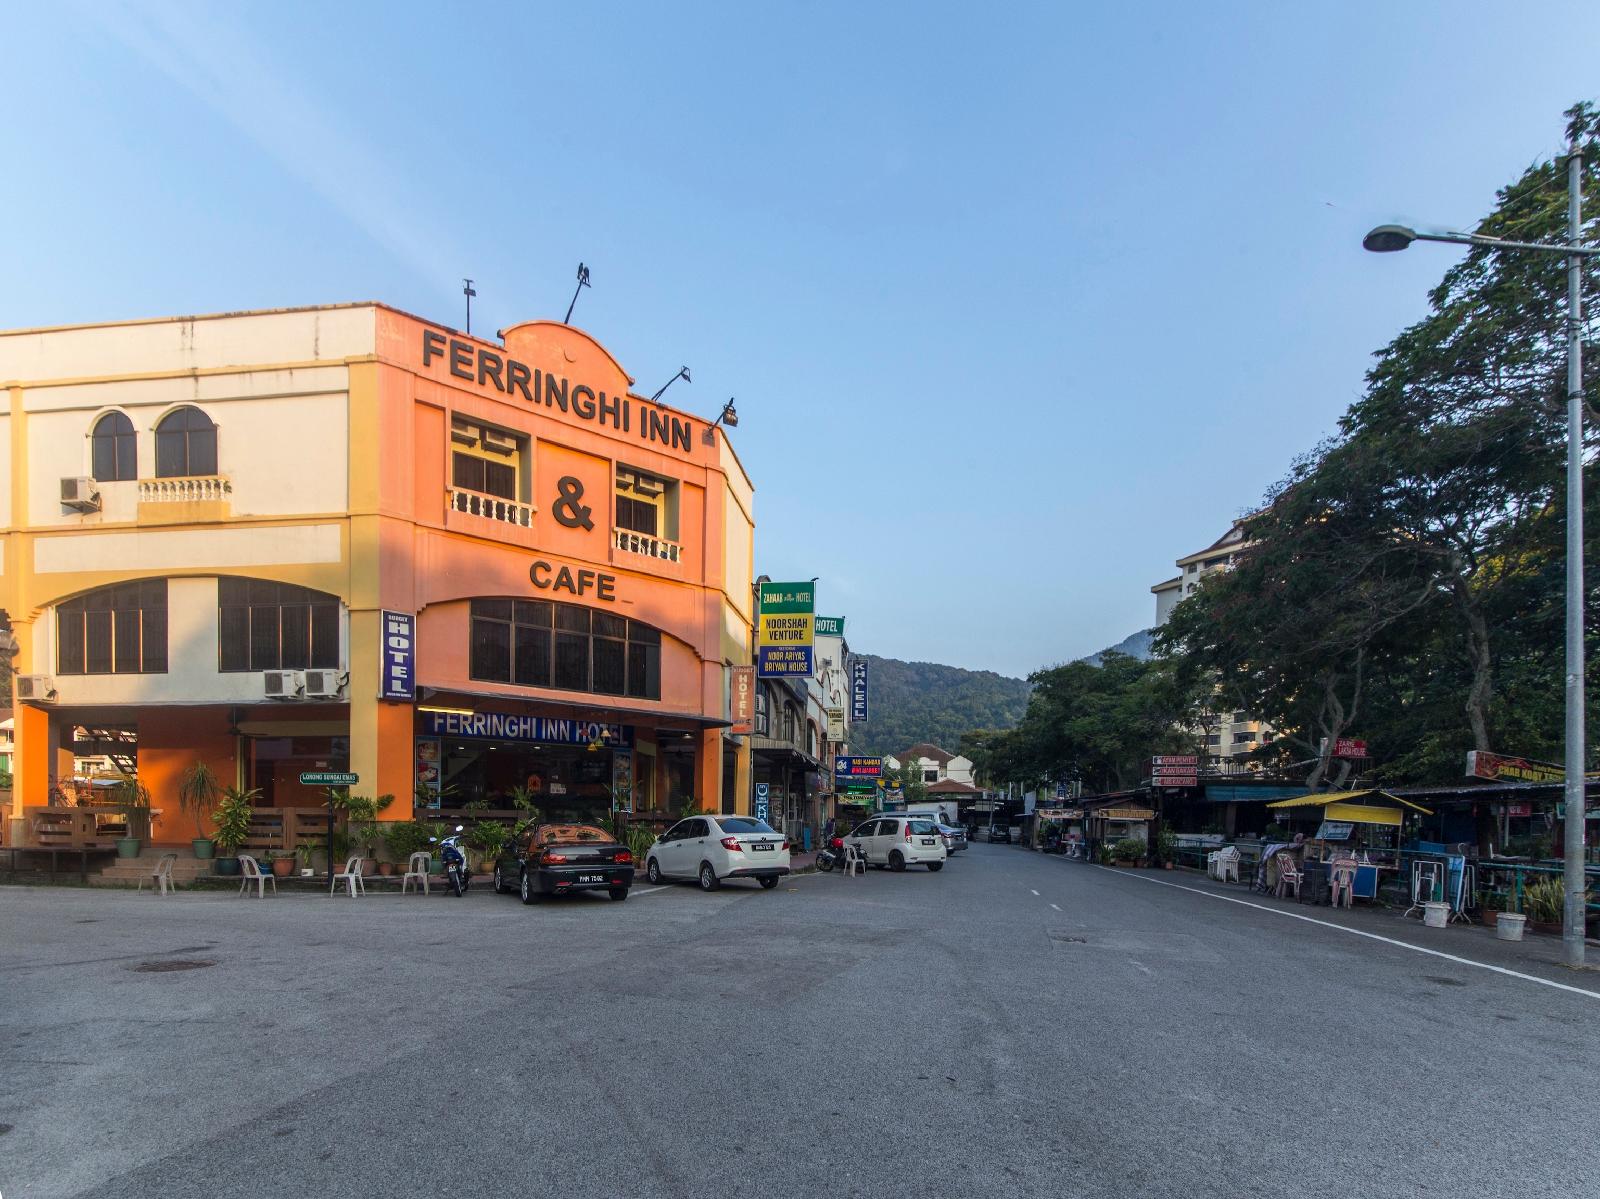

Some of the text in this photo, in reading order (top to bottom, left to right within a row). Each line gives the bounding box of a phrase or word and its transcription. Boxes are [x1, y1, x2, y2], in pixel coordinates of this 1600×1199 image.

[423, 328, 692, 452] FERRINGHI INN
[551, 475, 595, 532] &
[529, 561, 616, 602] CAFE
[795, 592, 811, 603] HOTEL
[766, 618, 808, 629] NOORSHAH
[769, 629, 804, 641] VENTURE
[815, 619, 838, 633] HOTEL
[388, 621, 410, 693] HOTEL
[764, 661, 808, 672] BRIYANI HOUSE
[768, 651, 806, 661] NOOR ARIYAS
[738, 674, 748, 718] HOTEL
[854, 663, 866, 717] KHALEEL
[434, 712, 628, 746] FERRINGHI INN HOTEL
